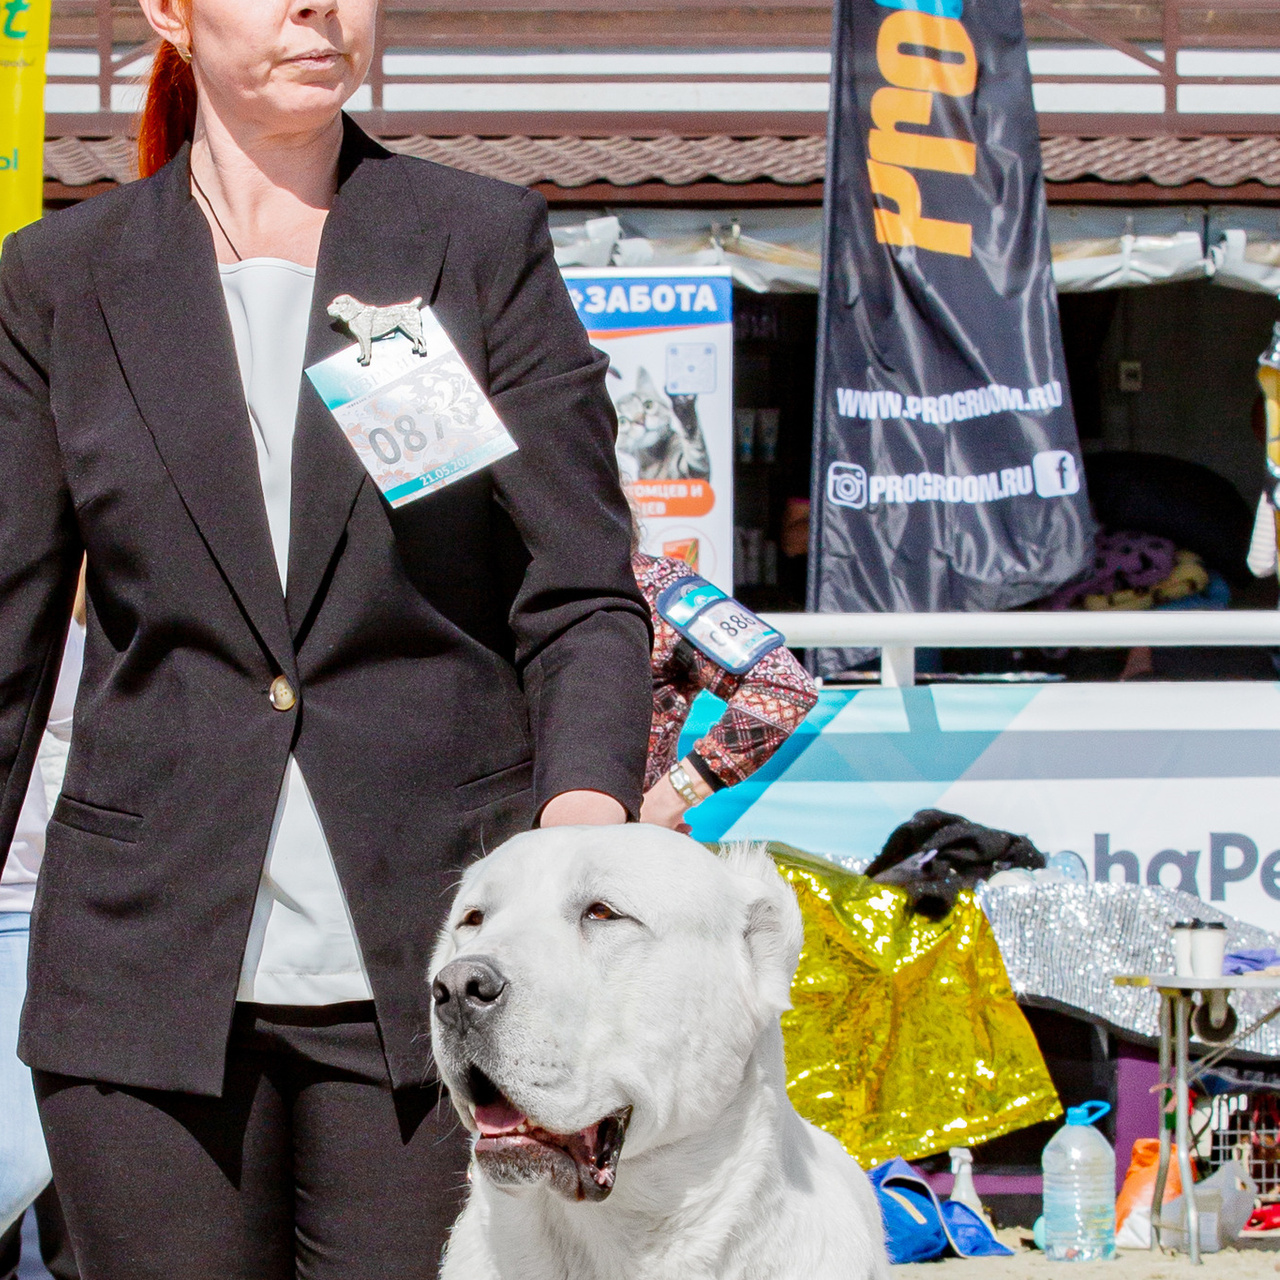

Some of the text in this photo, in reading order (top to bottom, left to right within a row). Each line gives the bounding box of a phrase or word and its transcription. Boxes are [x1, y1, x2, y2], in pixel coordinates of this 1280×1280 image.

[584, 284, 718, 314] ЗАБОТА
[836, 380, 1062, 424] WWW.PROGROOM.RU
[870, 465, 1033, 503] PROGROOM.RU
